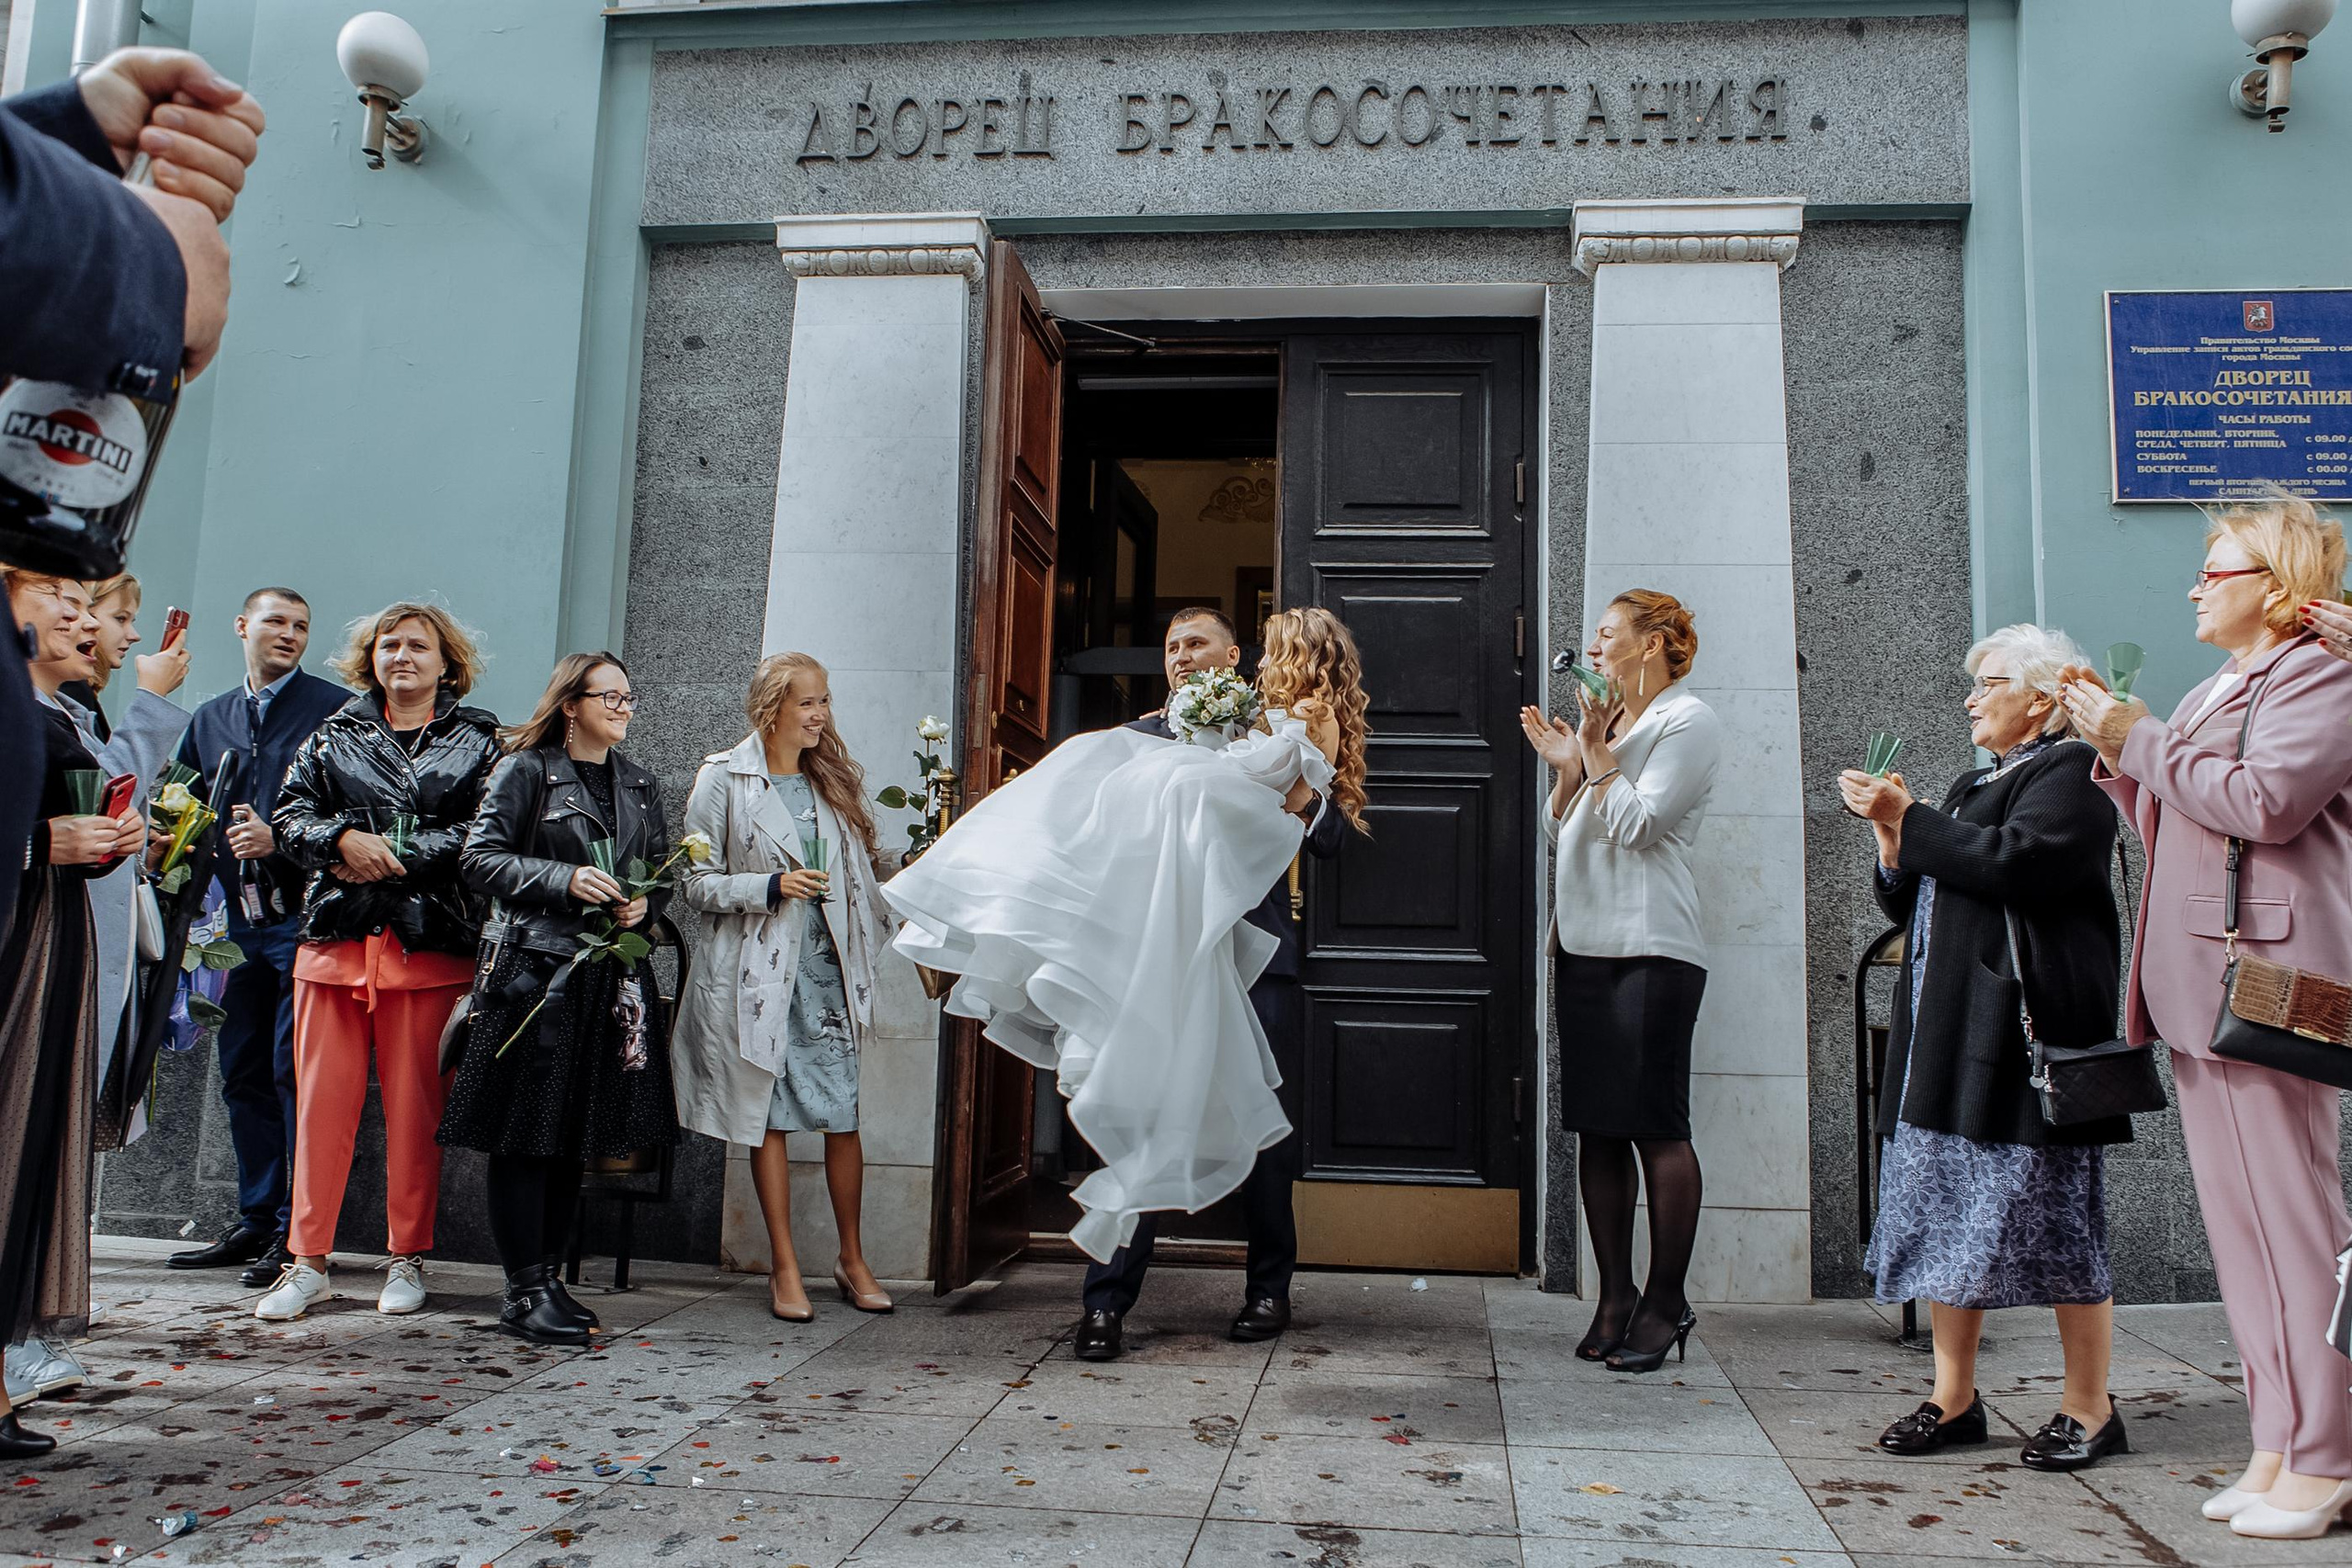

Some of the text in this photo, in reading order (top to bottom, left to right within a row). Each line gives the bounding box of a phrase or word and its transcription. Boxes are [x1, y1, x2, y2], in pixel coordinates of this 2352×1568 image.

[796, 79, 1788, 165] ДВОРЕЦ БРАКОСОЧЕТАНИЯ
[2279, 336, 2321, 344] Москвы
[2131, 345, 2191, 355] Управление
[2214, 370, 2312, 389] ДВОРЕЦ
[2133, 390, 2352, 406] БРАКОСОЧЕТАНИЯ
[2218, 415, 2312, 424] ЧАСЫ РАБОТЫ
[6, 412, 131, 471] MARTINI
[2314, 434, 2346, 443] 09.00
[2233, 440, 2287, 449] ПЯТНИЦА
[2136, 453, 2188, 461] СУББОТА
[2315, 452, 2347, 460] 09.00
[2137, 465, 2218, 473] ВОСКРЕСЕНЬЕ
[2316, 465, 2348, 473] 00.00
